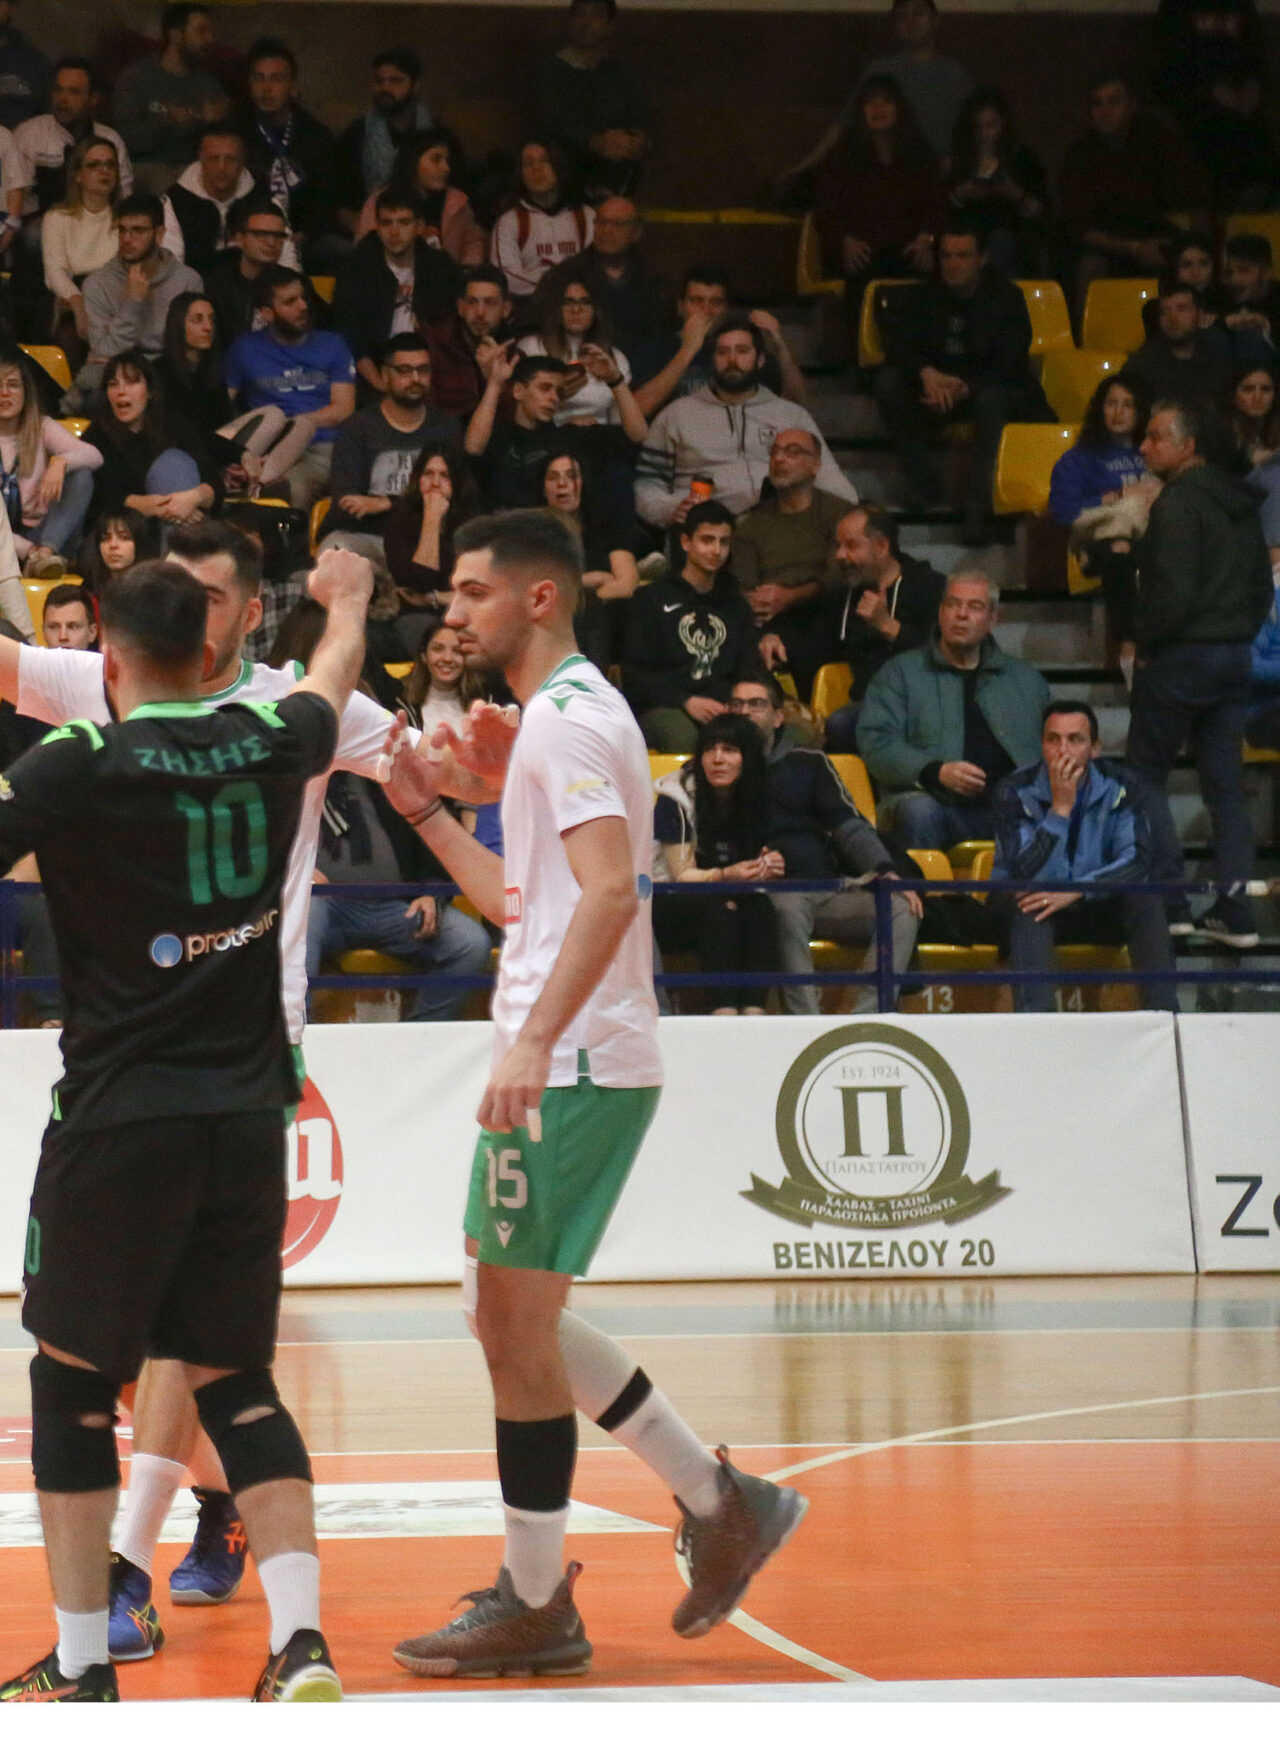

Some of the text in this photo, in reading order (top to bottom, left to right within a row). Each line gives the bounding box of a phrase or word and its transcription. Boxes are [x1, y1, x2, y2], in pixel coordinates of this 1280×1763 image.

[133, 735, 272, 776] ΖΗΣΗΣ
[174, 780, 269, 905] 10
[922, 985, 954, 1013] 13
[485, 1147, 528, 1209] 15
[773, 1238, 996, 1270] ΒΕΝΙΖΕΛΟΥ 20
